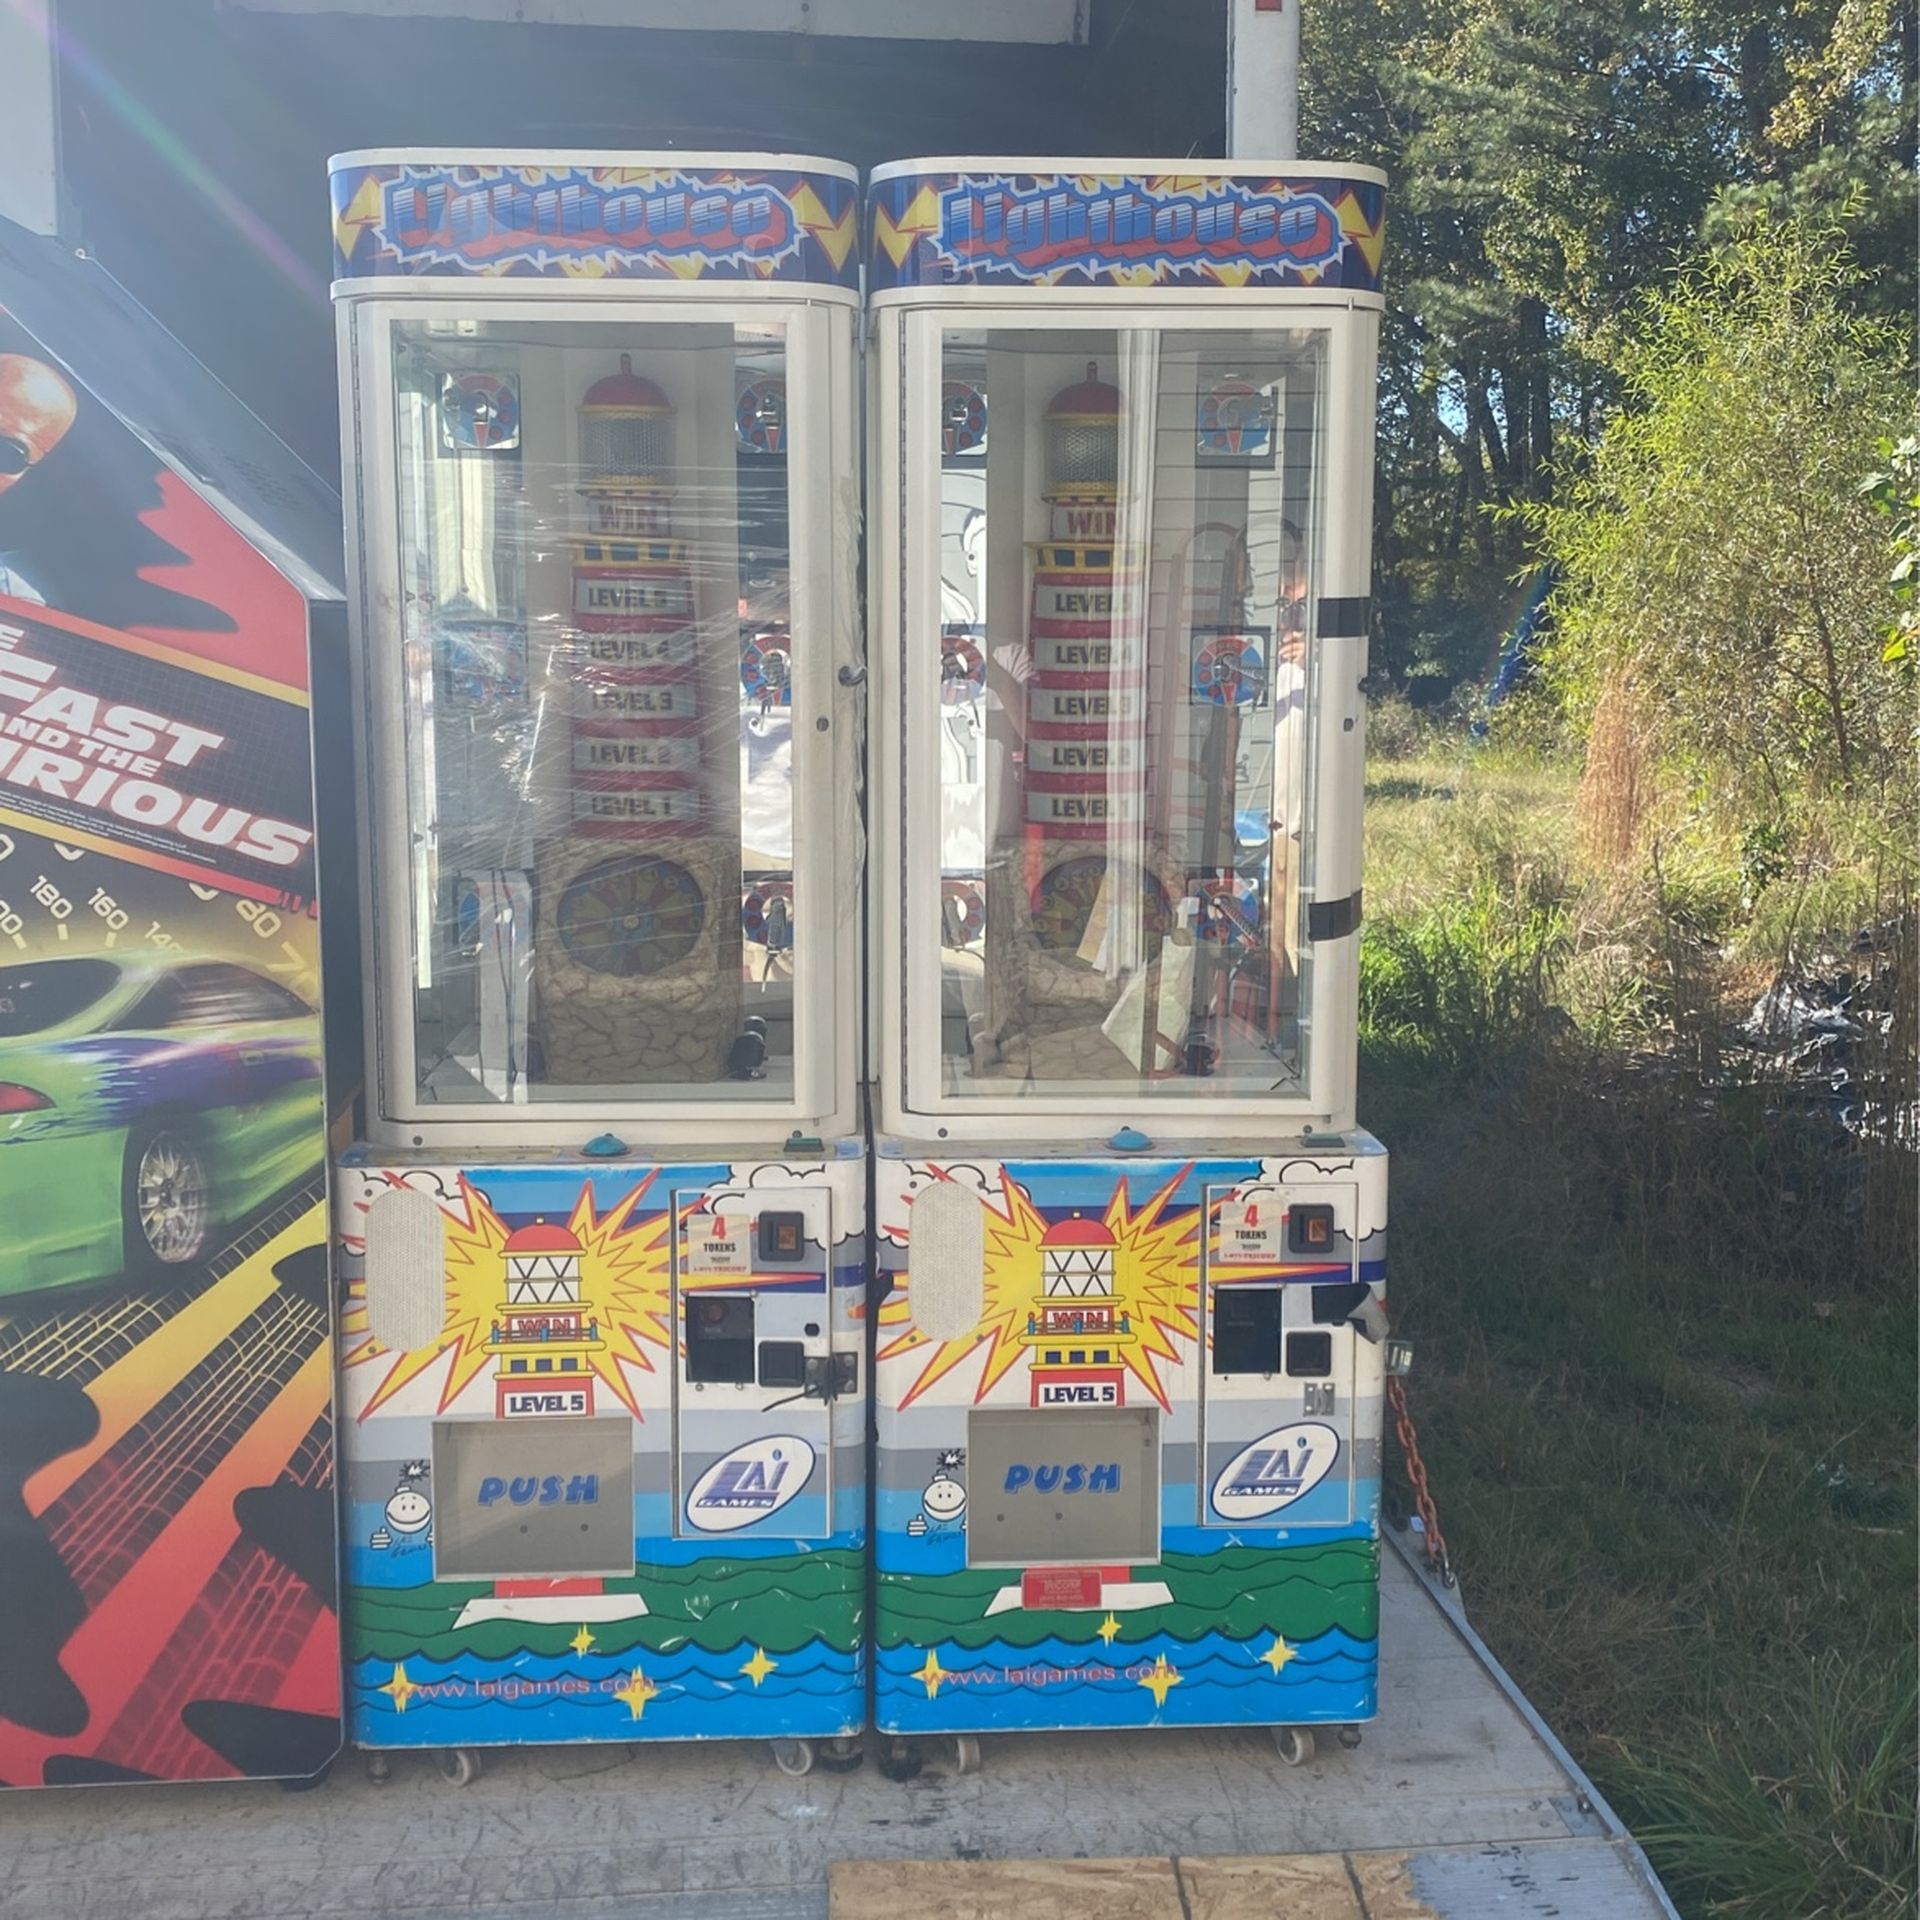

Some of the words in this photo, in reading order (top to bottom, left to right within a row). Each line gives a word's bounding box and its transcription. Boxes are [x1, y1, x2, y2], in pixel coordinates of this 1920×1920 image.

[391, 182, 771, 247] Lighthouse
[949, 190, 1328, 255] Lighthouse
[588, 587, 650, 608] LEVEL
[0, 712, 70, 749] ND
[79, 738, 162, 778] THE
[590, 744, 655, 765] LEVEL
[0, 736, 312, 866] RIOUS
[591, 797, 658, 816] LEVEL
[30, 874, 73, 919] 180
[88, 886, 129, 931] 160
[1243, 1204, 1259, 1228] 4
[711, 1215, 727, 1241] 4
[1234, 1229, 1267, 1240] TOKENS
[703, 1242, 736, 1253] TOKENS
[517, 1318, 571, 1338] WN
[1052, 1311, 1104, 1333] WN
[509, 1394, 567, 1413] LEVEL
[570, 1394, 584, 1412] 5
[1043, 1386, 1099, 1404] LEVEL
[1102, 1385, 1115, 1403] 5
[477, 1473, 599, 1508] PUSH
[1003, 1462, 1122, 1496] PUSH
[1221, 1486, 1299, 1496] GAMES
